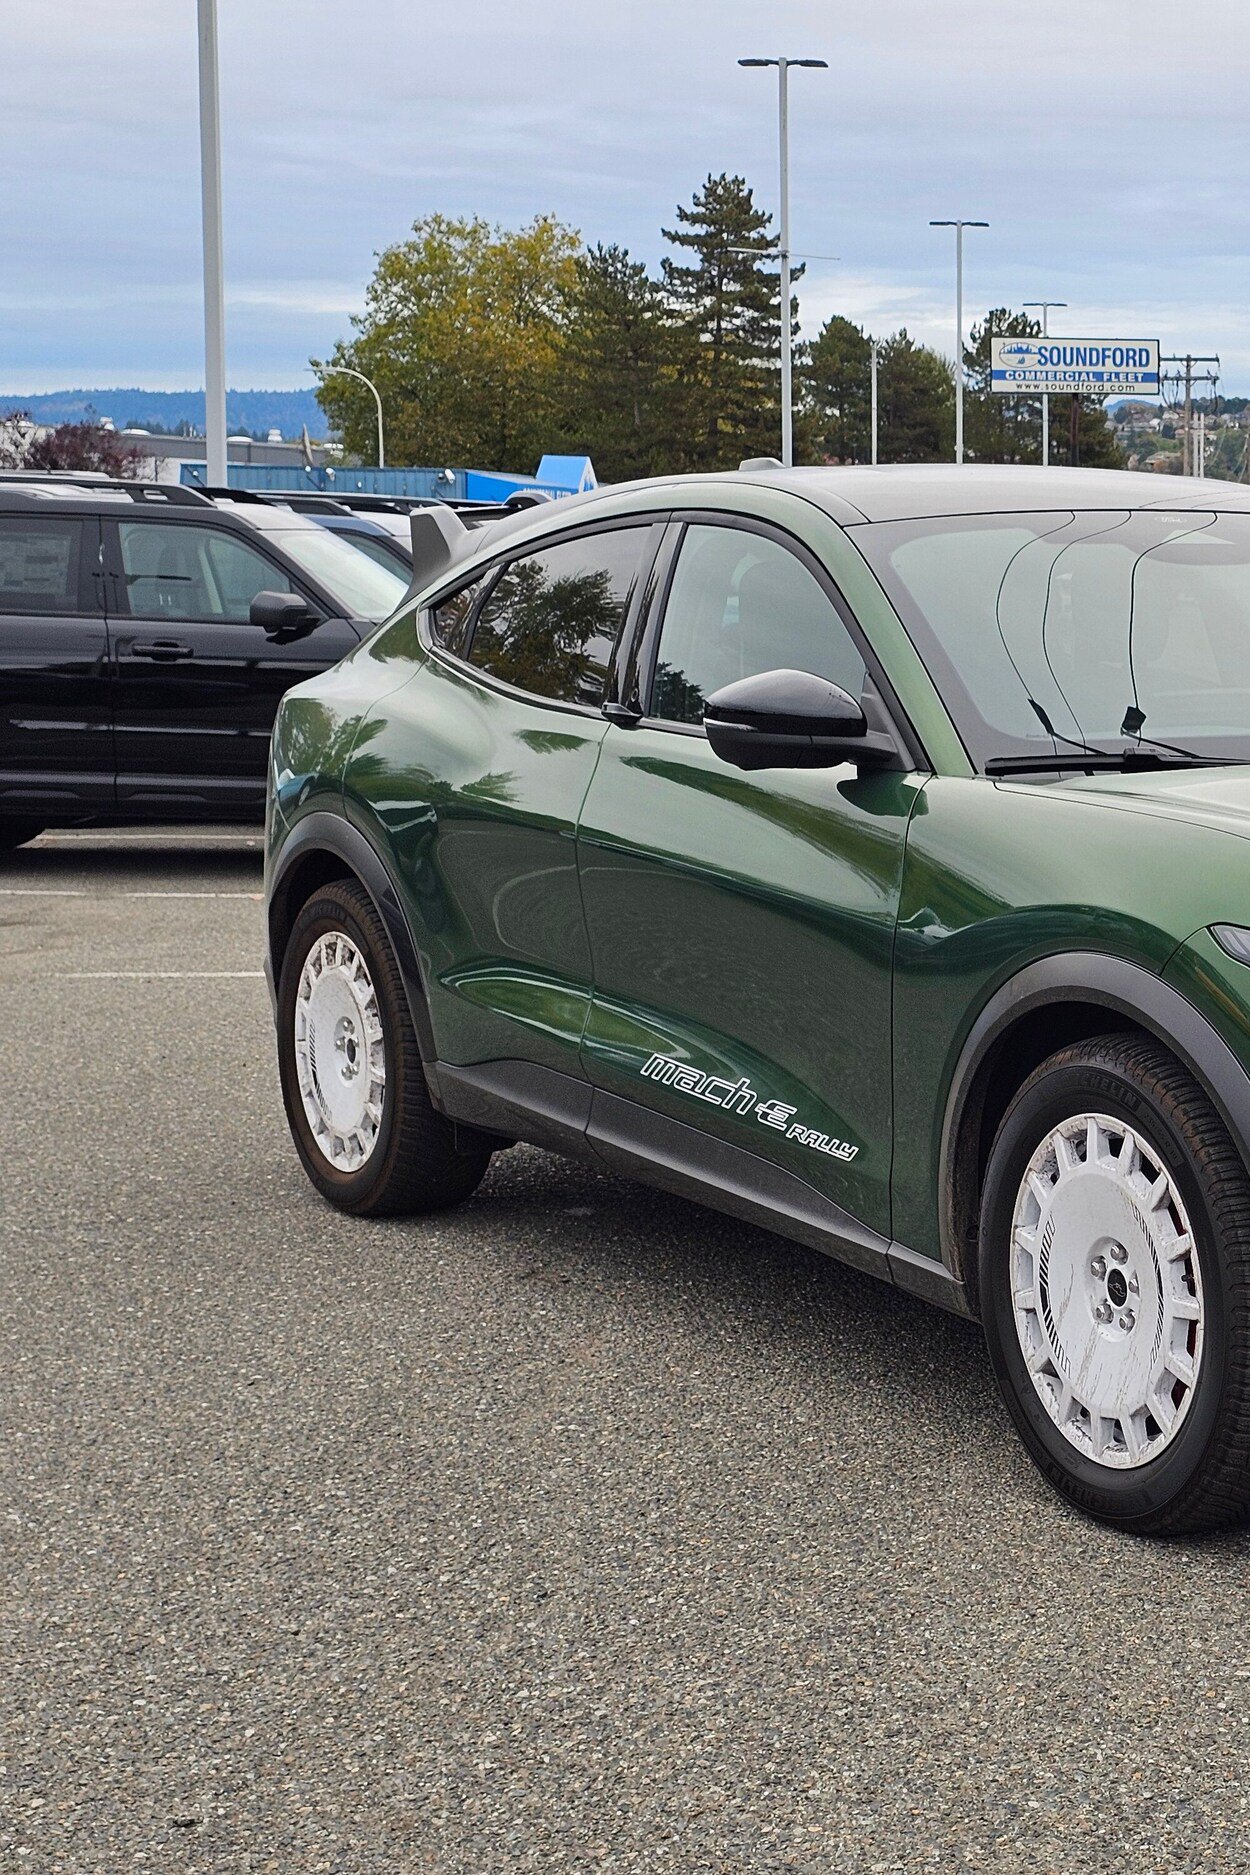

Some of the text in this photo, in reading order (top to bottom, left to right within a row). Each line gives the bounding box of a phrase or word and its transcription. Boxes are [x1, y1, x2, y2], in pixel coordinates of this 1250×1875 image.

[1037, 345, 1151, 369] SOUNDFORD
[1004, 371, 1144, 383] COMMERCIAL FLEET
[1015, 381, 1136, 393] www.soundford.com
[786, 1122, 859, 1162] RALLY
